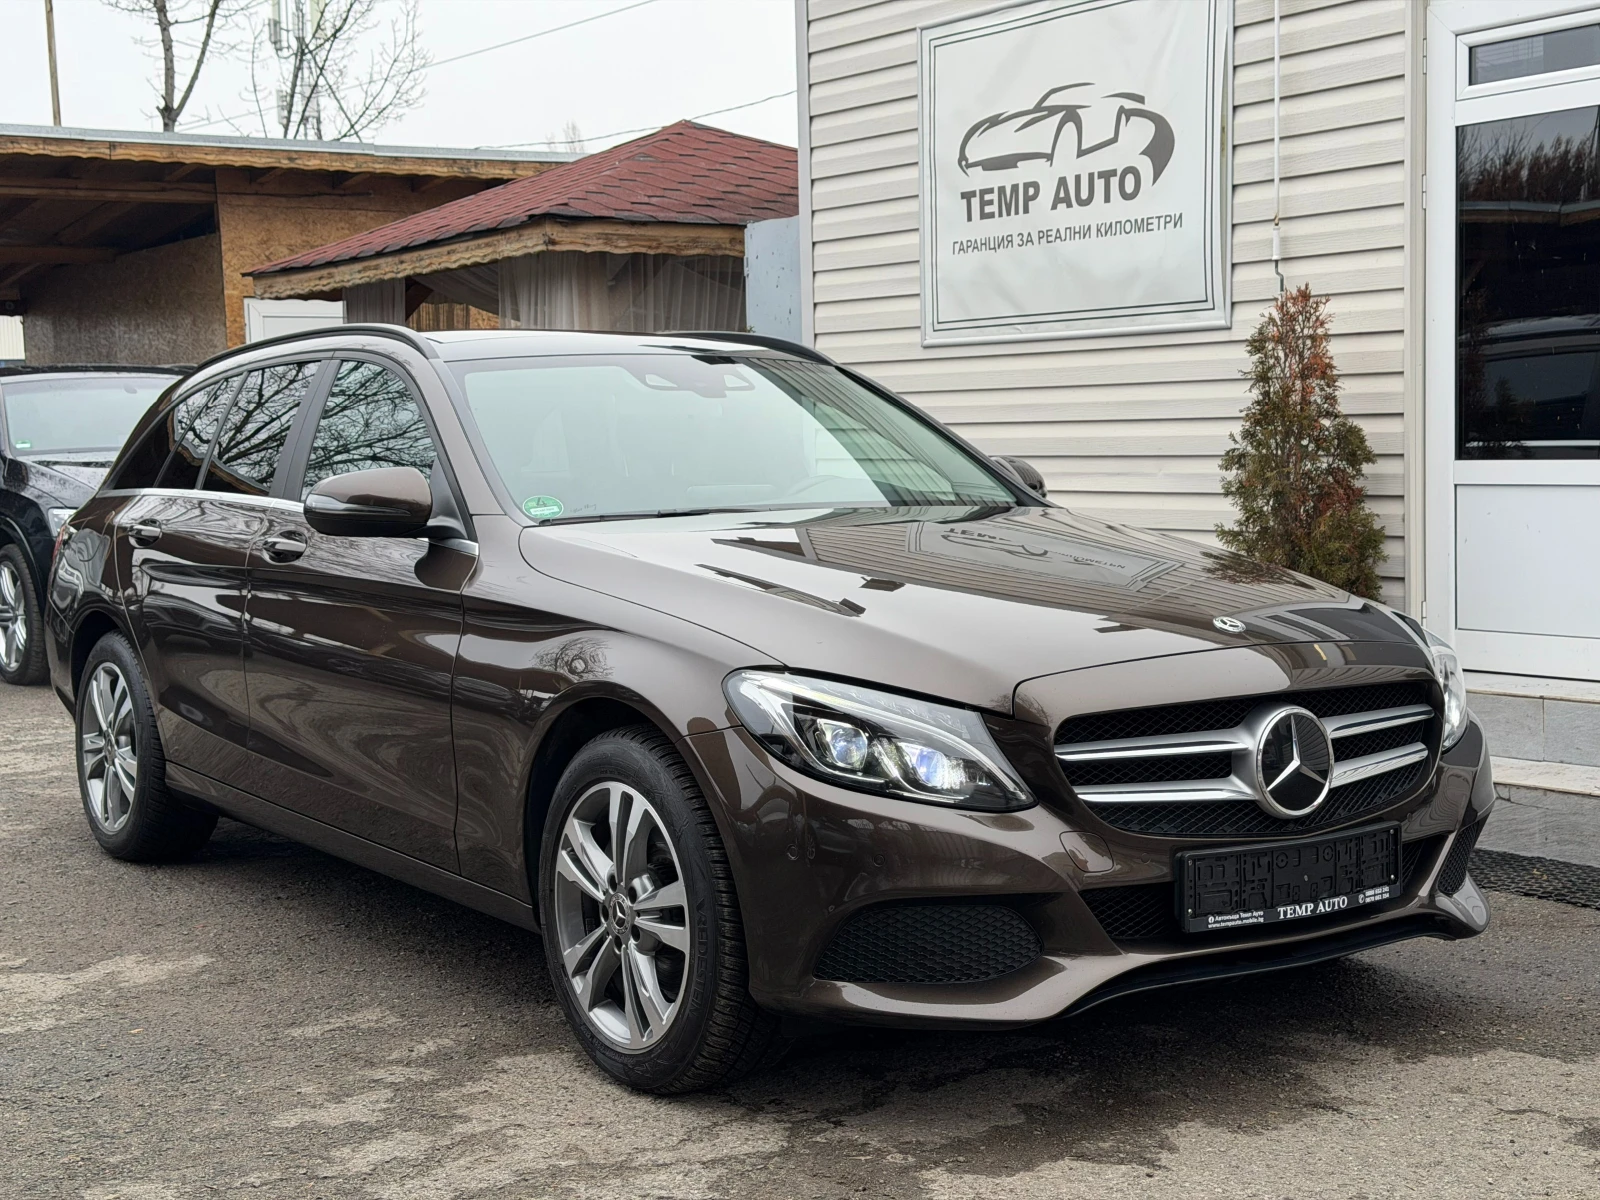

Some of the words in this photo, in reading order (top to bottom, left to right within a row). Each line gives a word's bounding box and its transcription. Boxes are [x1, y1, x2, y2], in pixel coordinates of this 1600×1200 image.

[960, 180, 1041, 223] TEMP
[1050, 166, 1142, 211] AUTO
[952, 234, 1014, 255] ГАРАНЦИЯ
[1017, 230, 1034, 248] ЗА
[1038, 224, 1092, 245] РЕАЛНИ
[1096, 212, 1183, 239] КИЛОМЕТРИ
[1277, 903, 1314, 919] TEMP
[1316, 896, 1348, 913] AUTO
[688, 897, 709, 1018] VREDESTEIN
